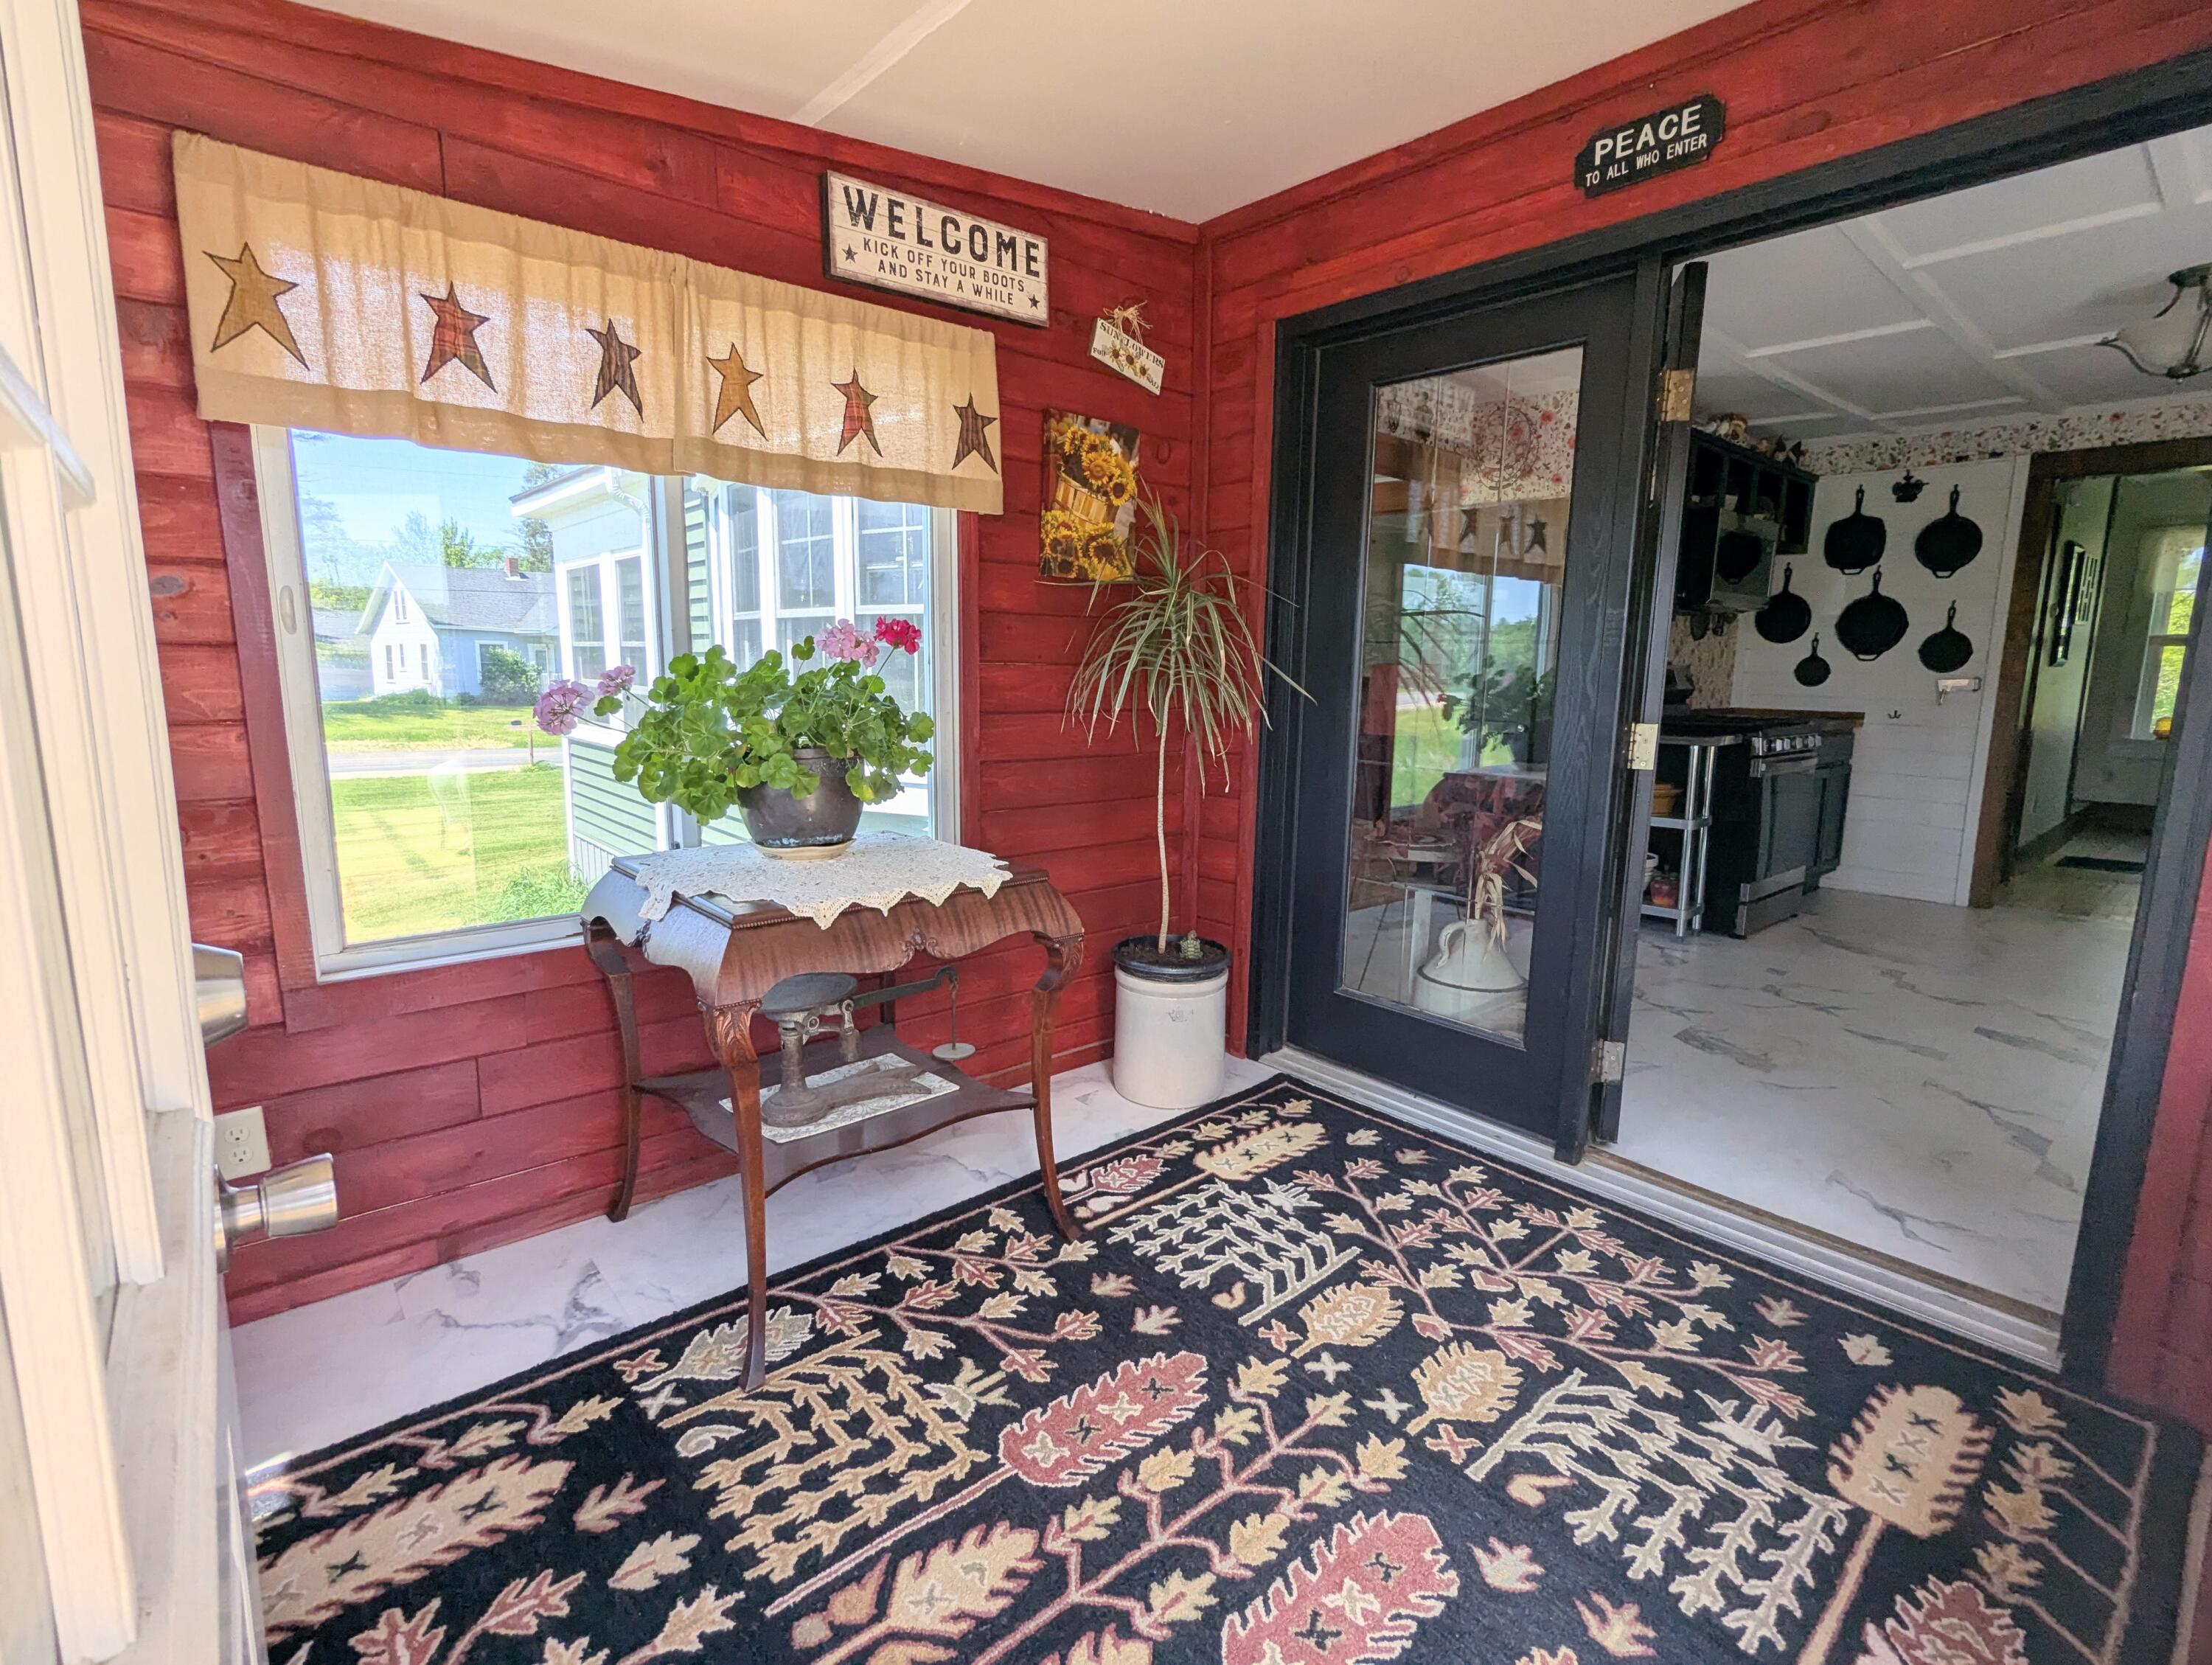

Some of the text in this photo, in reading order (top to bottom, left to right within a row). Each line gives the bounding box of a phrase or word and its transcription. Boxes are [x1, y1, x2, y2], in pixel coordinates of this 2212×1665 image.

[1586, 133, 1708, 187] TO ALL WHO ENTER
[1595, 104, 1702, 166] PEACE
[841, 184, 1040, 278] WELCOME
[863, 237, 1024, 292] KICK OFF YOUR BOOTS
[878, 260, 1013, 305] AND STAY A WHILE
[1099, 321, 1164, 368] SUNLOWERS
